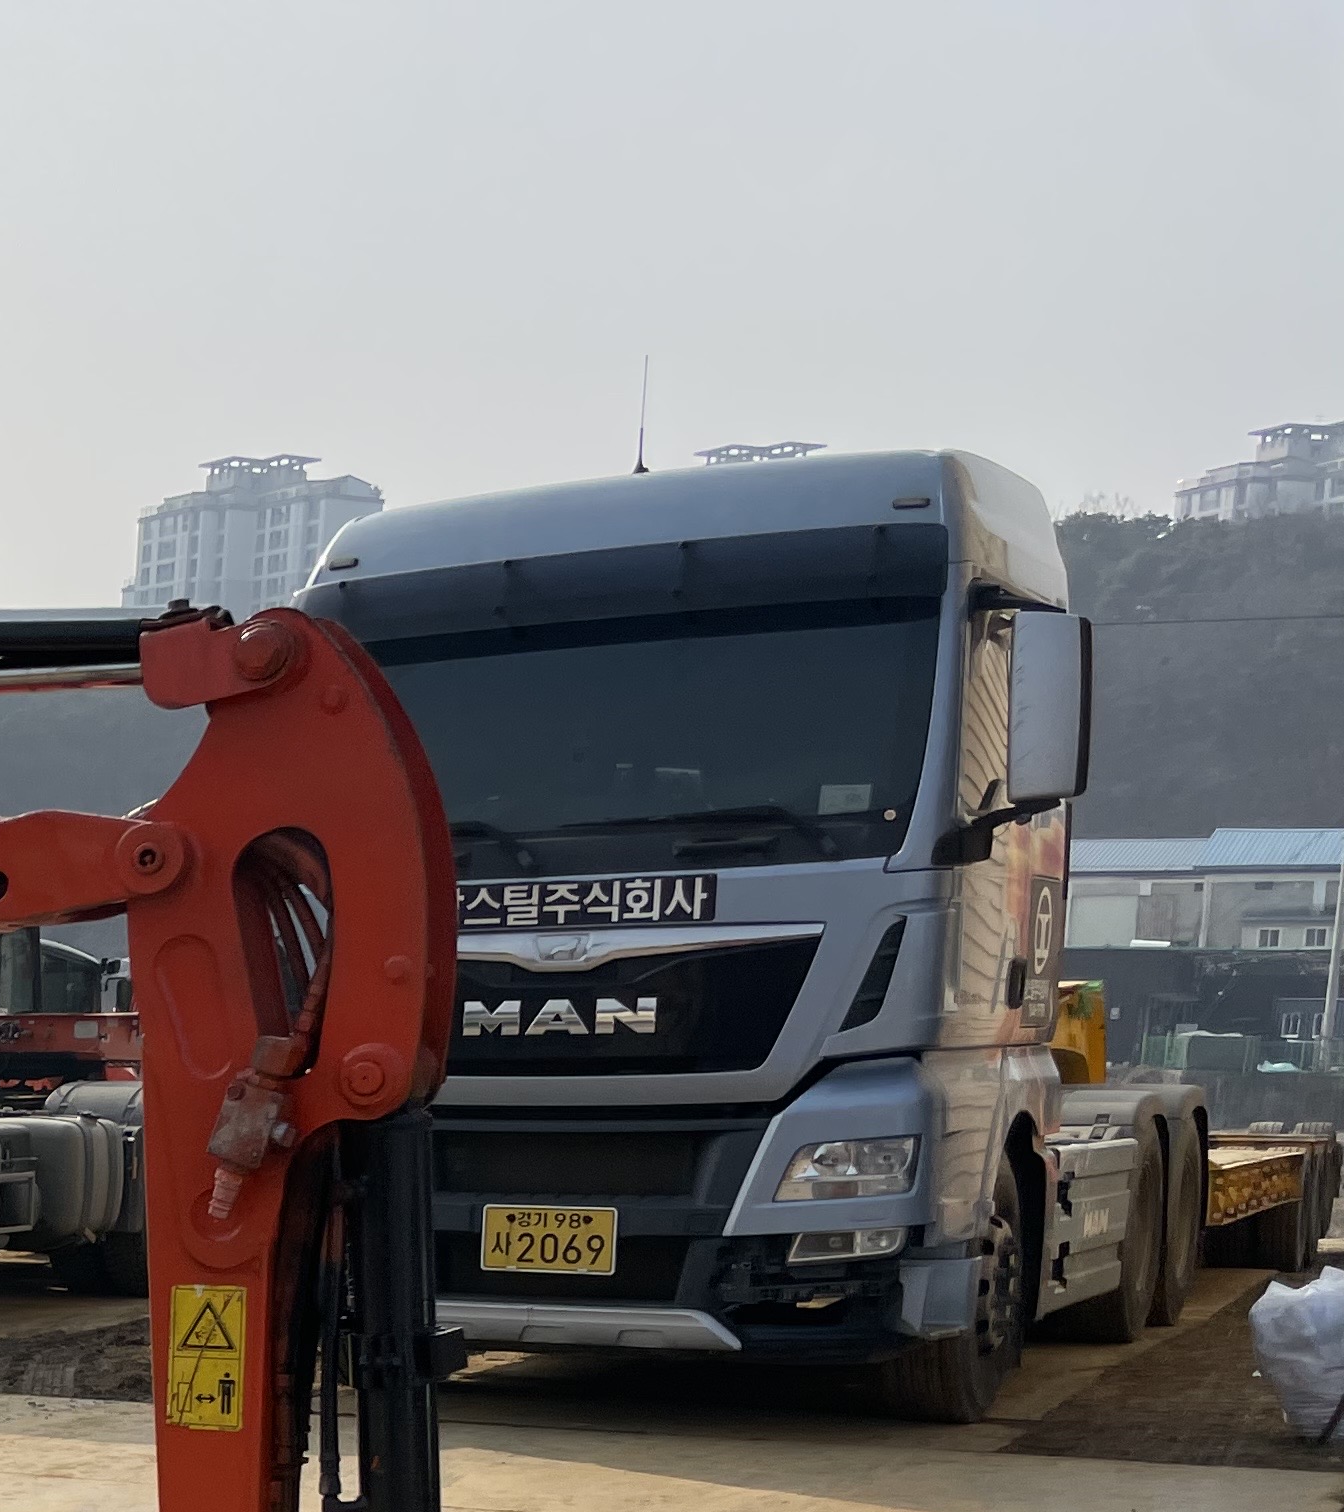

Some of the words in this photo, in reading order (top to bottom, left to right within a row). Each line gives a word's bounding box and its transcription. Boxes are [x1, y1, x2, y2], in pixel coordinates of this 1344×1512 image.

[462, 996, 658, 1037] MAN
[517, 1211, 548, 1228] 경기
[554, 1212, 581, 1229] 98
